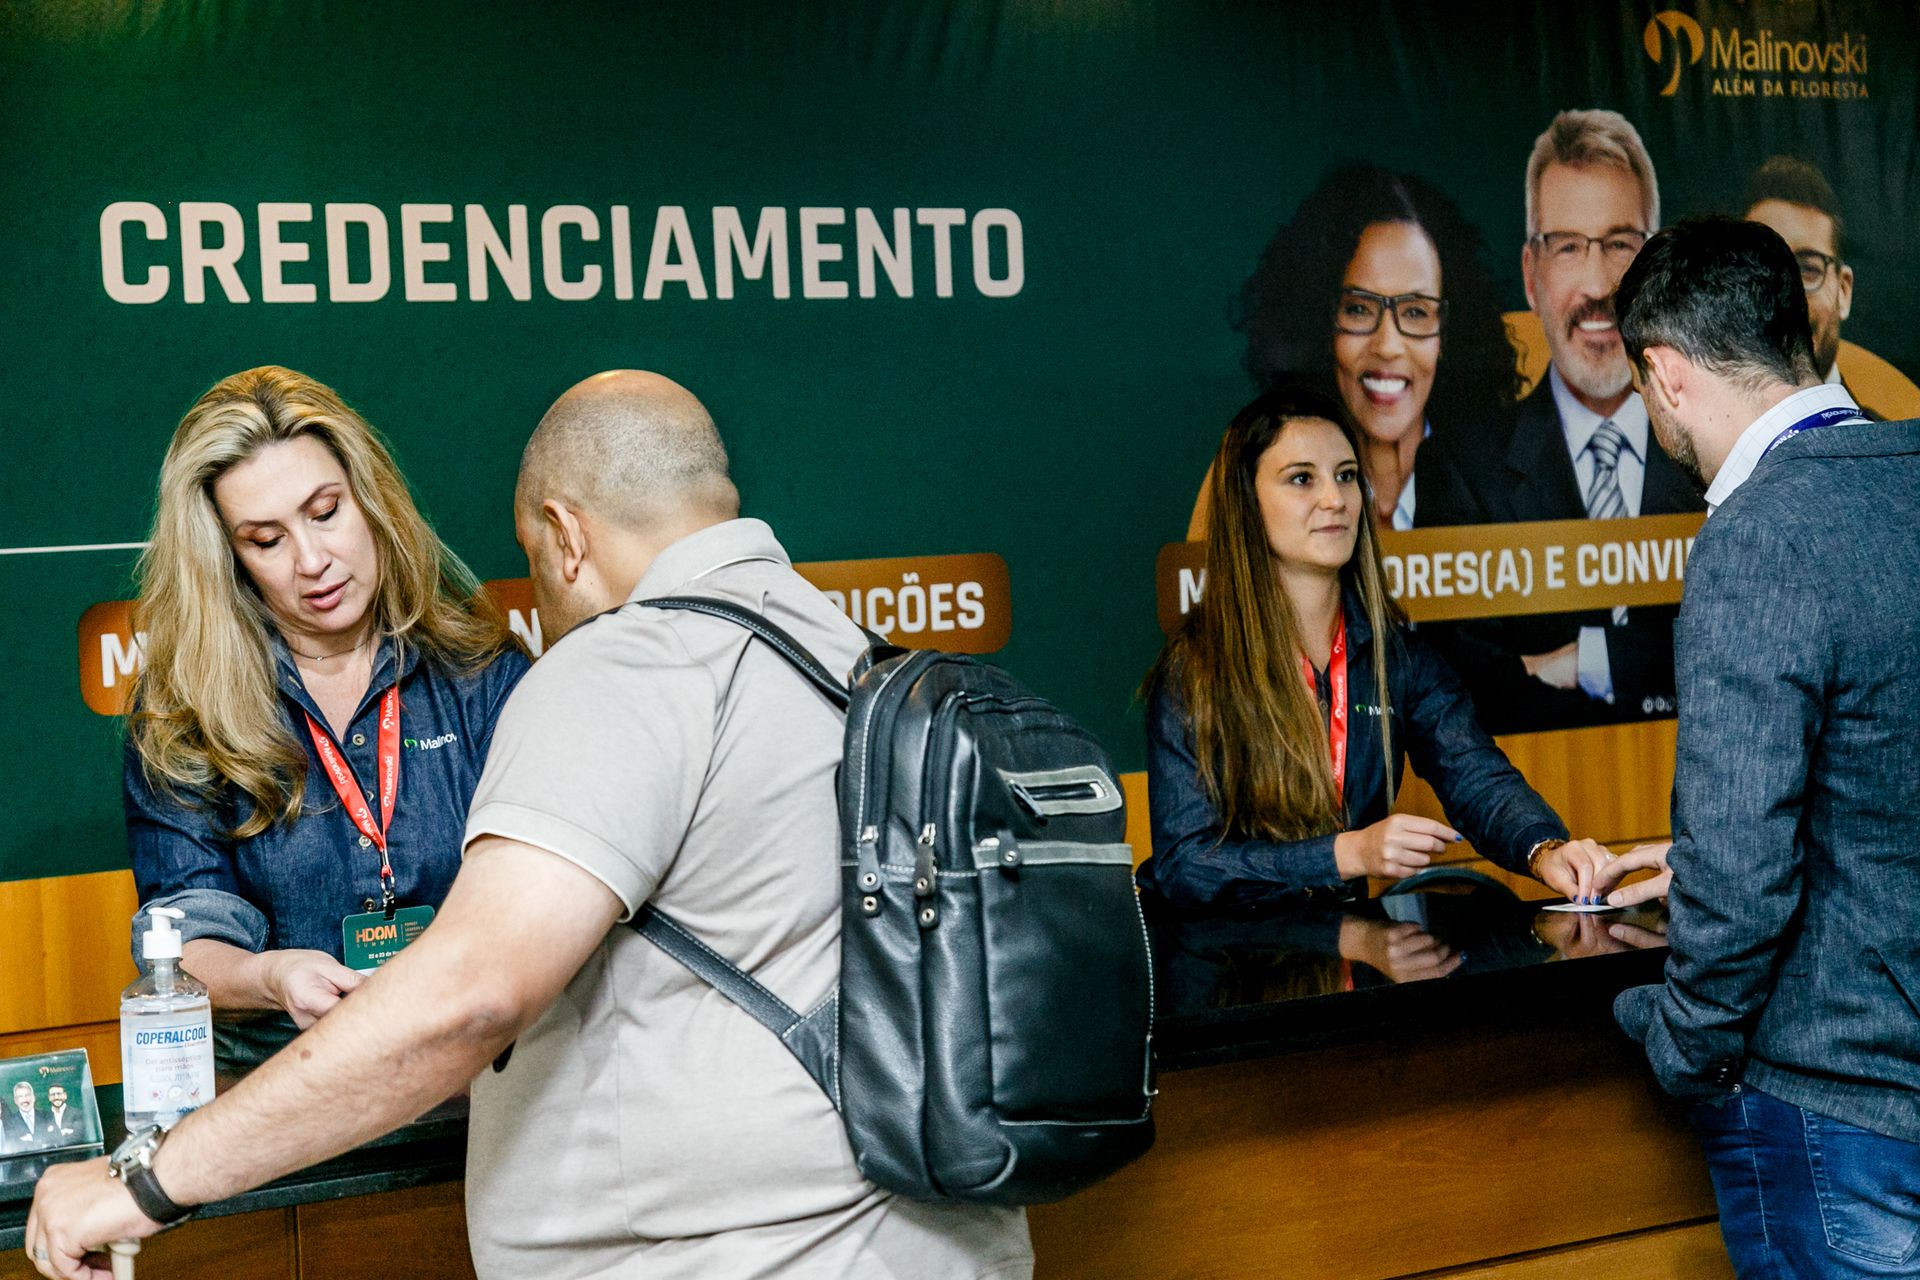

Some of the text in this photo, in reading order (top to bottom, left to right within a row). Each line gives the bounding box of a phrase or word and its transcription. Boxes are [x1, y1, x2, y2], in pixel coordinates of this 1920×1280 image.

[1710, 26, 1868, 75] Malinovski
[1712, 73, 1869, 99] ALÉM DA FLORESTA
[99, 201, 1025, 304] CREDENCIAMENTO
[1545, 545, 1567, 590] E
[384, 755, 394, 797] Malinovski
[355, 925, 398, 943] HDOM
[136, 1026, 207, 1046] COPERALCOOL
